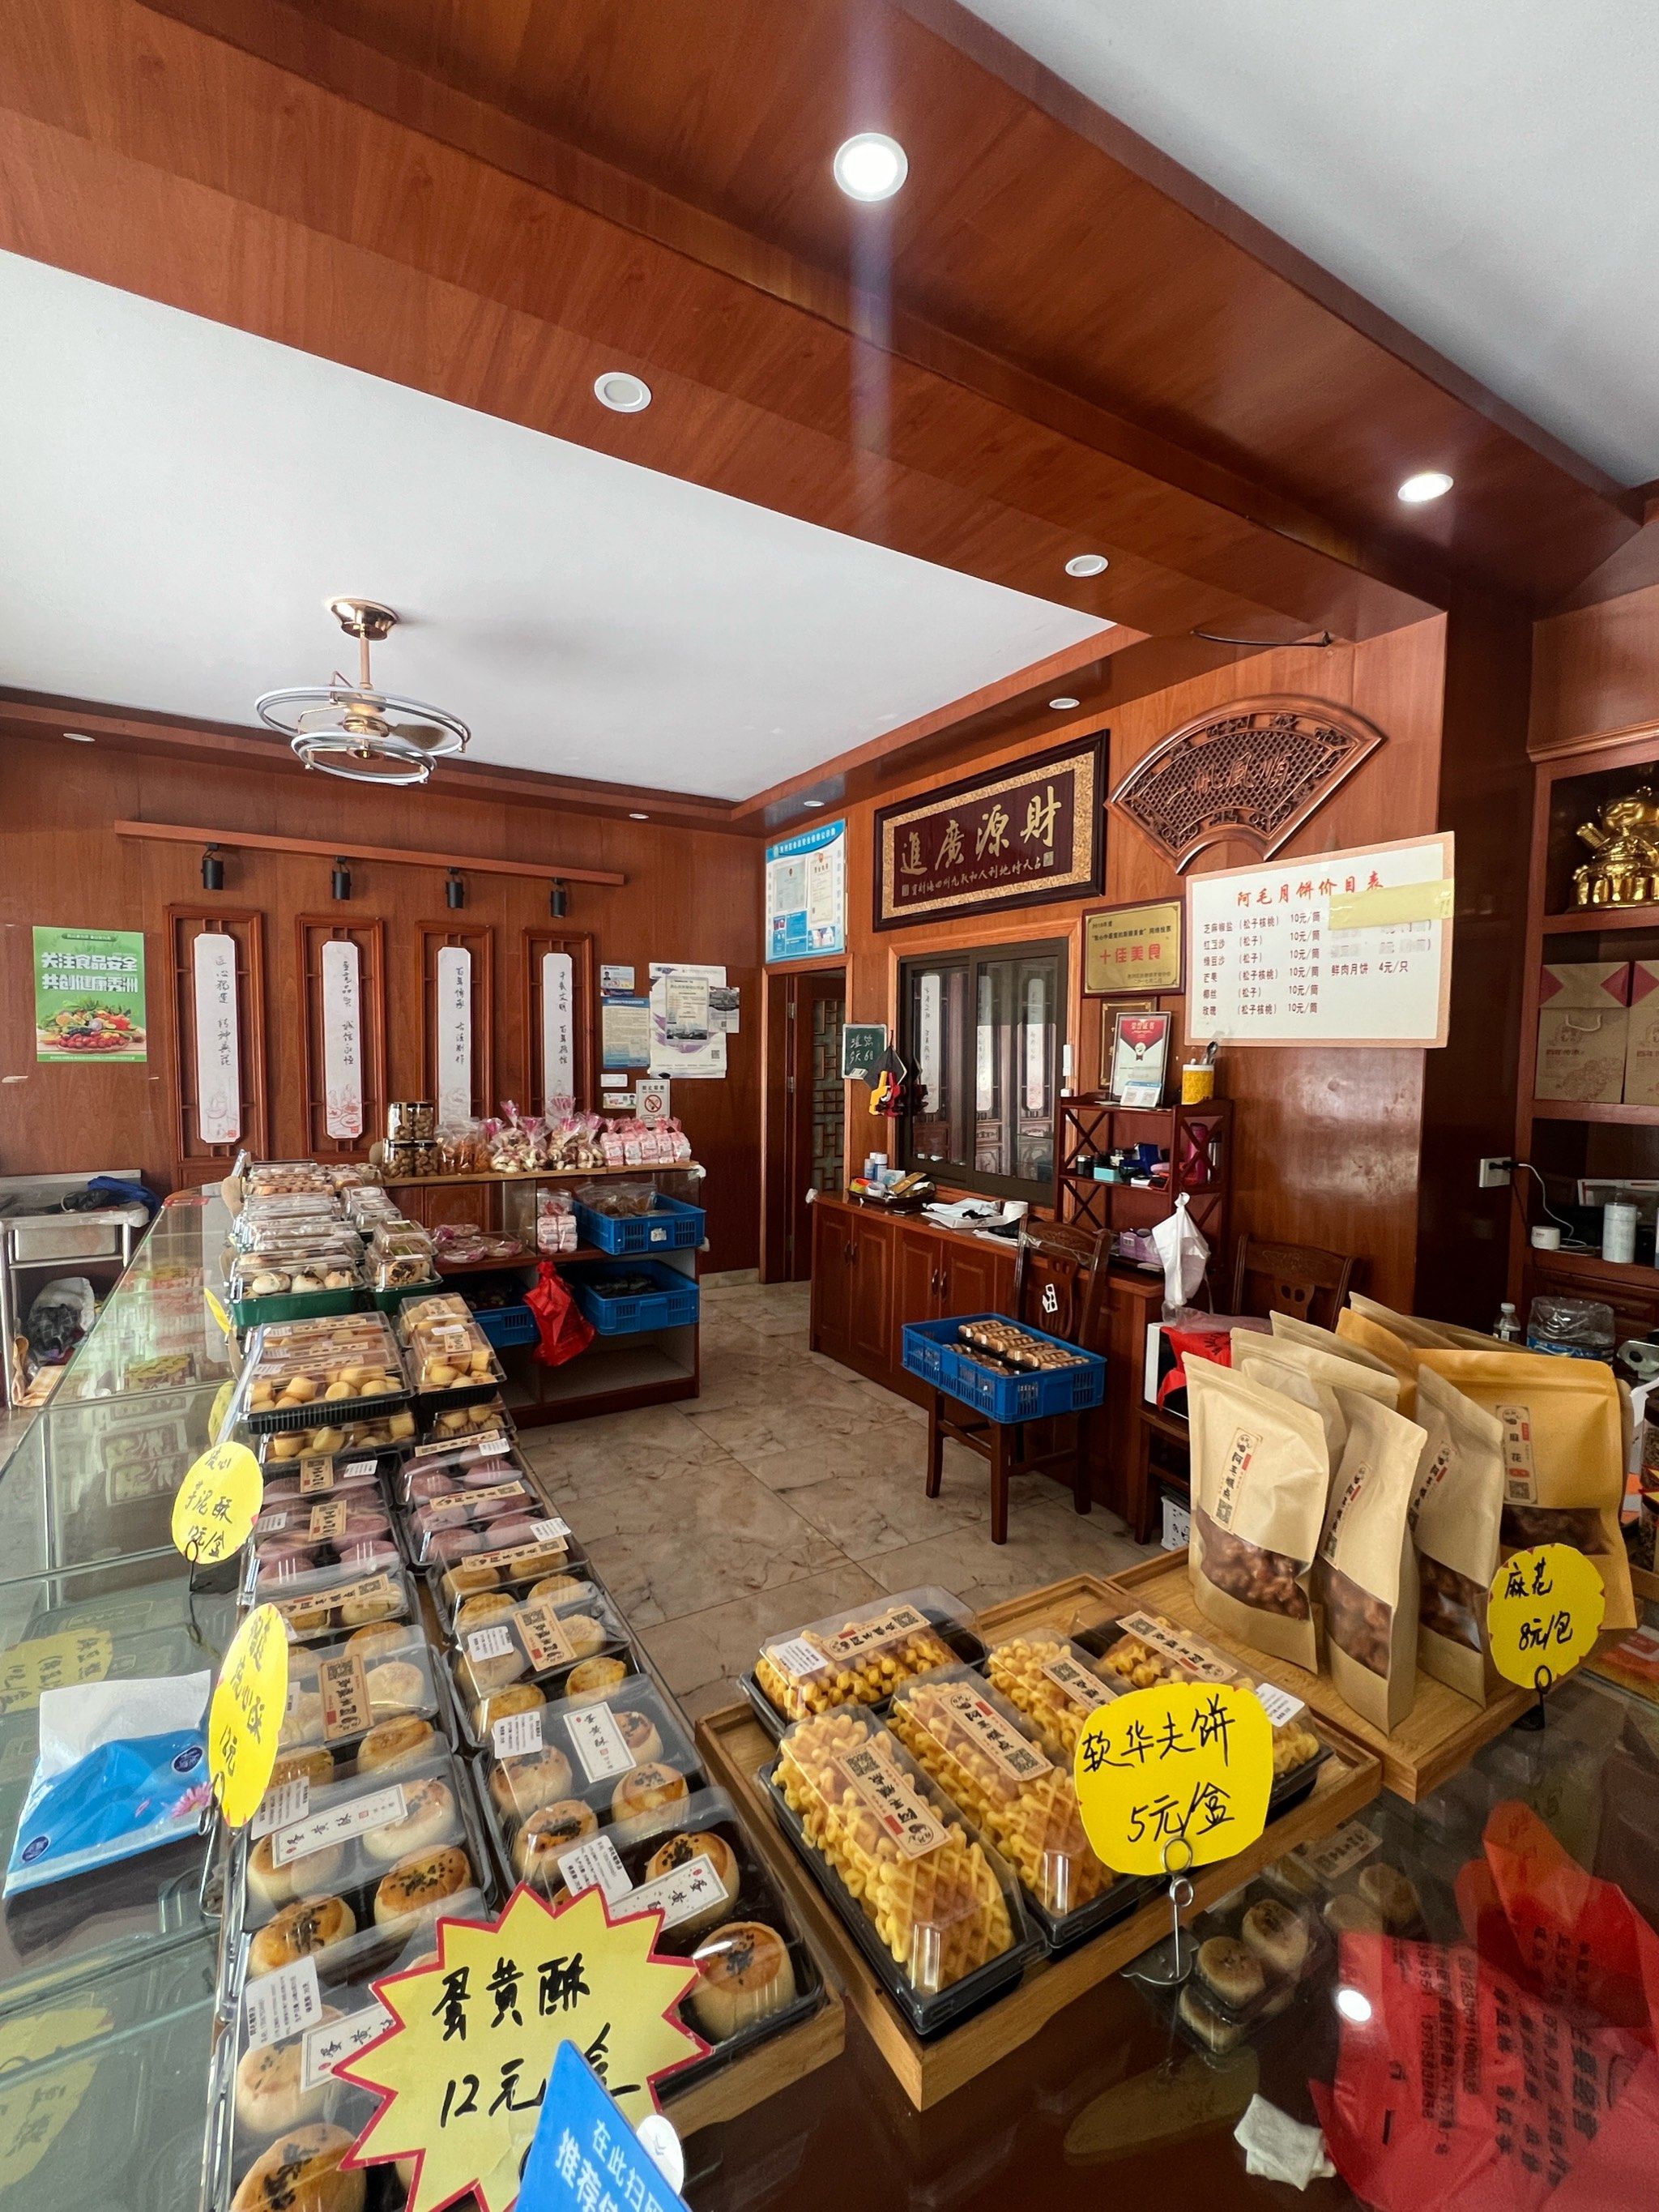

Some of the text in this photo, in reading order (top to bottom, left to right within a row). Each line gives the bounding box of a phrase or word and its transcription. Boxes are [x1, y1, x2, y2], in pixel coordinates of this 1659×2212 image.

[1237, 870, 1384, 907] 阿毛月饼价目表
[41, 952, 138, 972] 关注食品安全
[1100, 943, 1161, 964] 十佳美食
[1332, 963, 1368, 976] 鲜肉月饼
[41, 974, 139, 993] 共创健康秀洲
[1509, 1433, 1522, 1463] 麻花
[1504, 1557, 1553, 1599] 麻花
[1519, 1611, 1573, 1650] 8元/包
[1081, 1693, 1235, 1773] 软华夫饼
[1128, 1781, 1235, 1843] 5元/盒
[432, 1952, 591, 2042] 蛋黄酥
